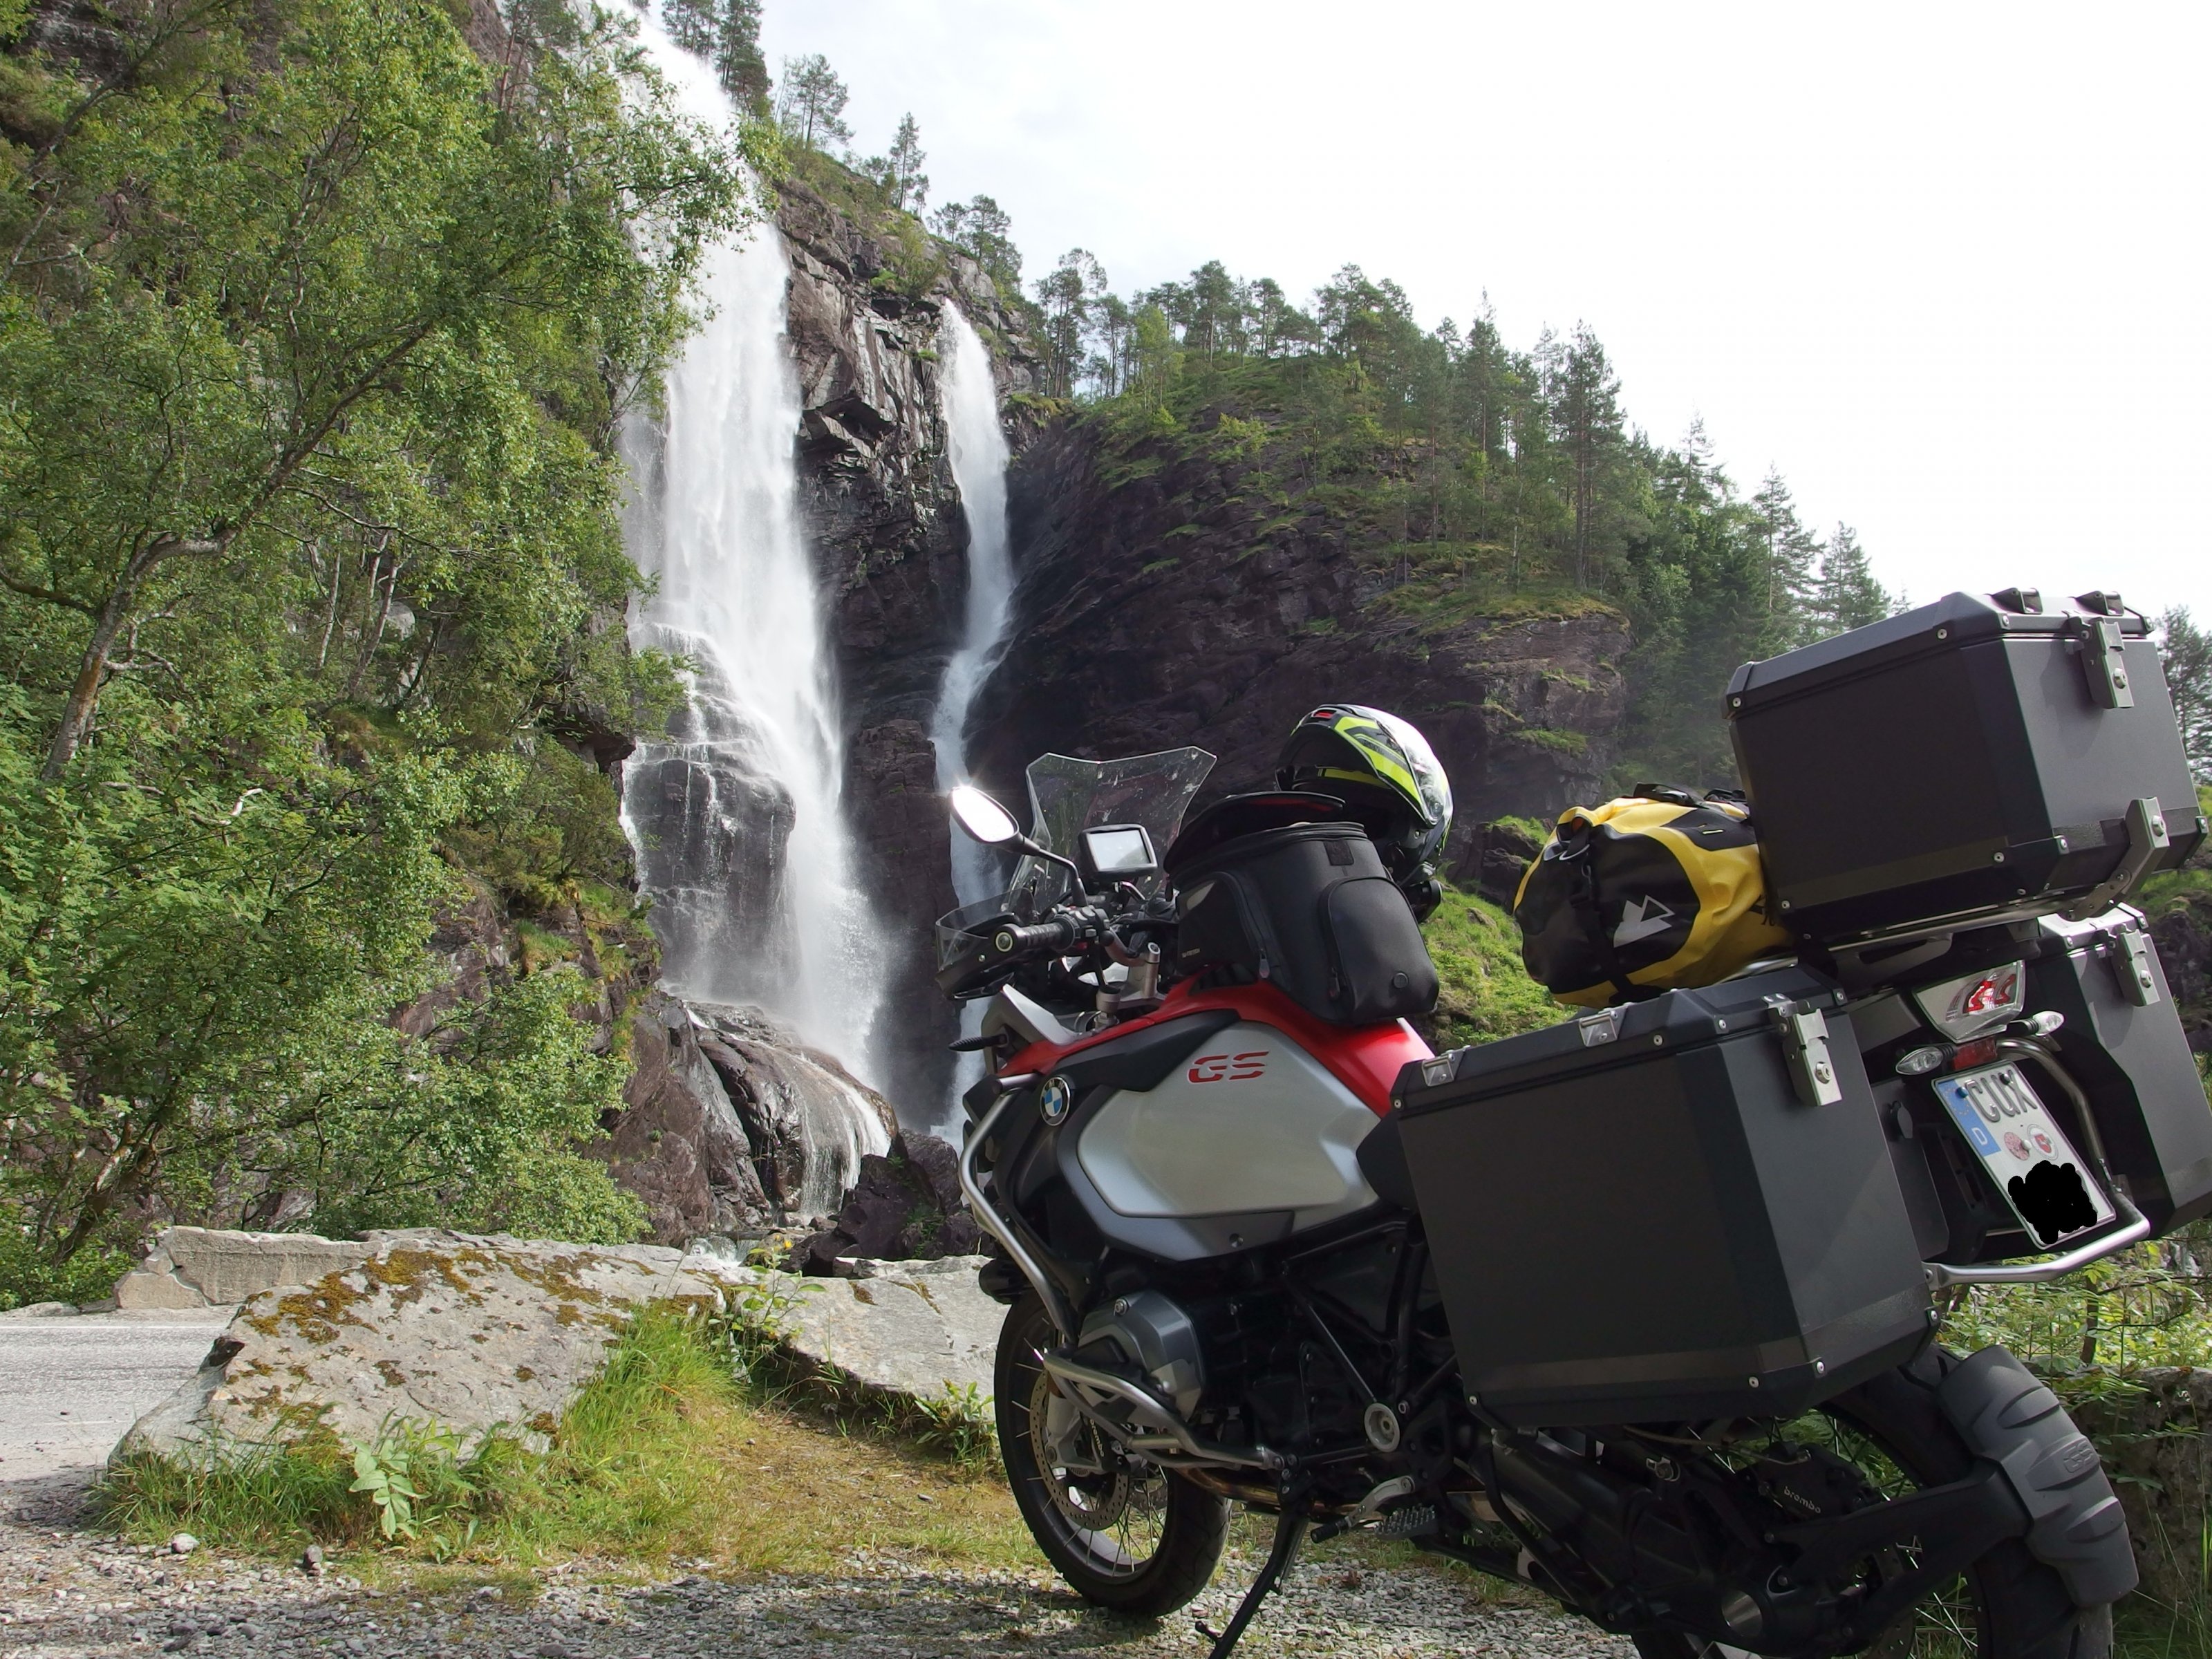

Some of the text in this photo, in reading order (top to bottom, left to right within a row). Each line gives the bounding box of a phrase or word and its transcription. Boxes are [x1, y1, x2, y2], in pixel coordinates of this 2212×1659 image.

[1188, 1051, 1270, 1084] GS
[1965, 1069, 2038, 1123] CUX
[1971, 1127, 1988, 1145] D
[2063, 1440, 2094, 1473] GS
[1783, 1485, 1821, 1514] brembo
